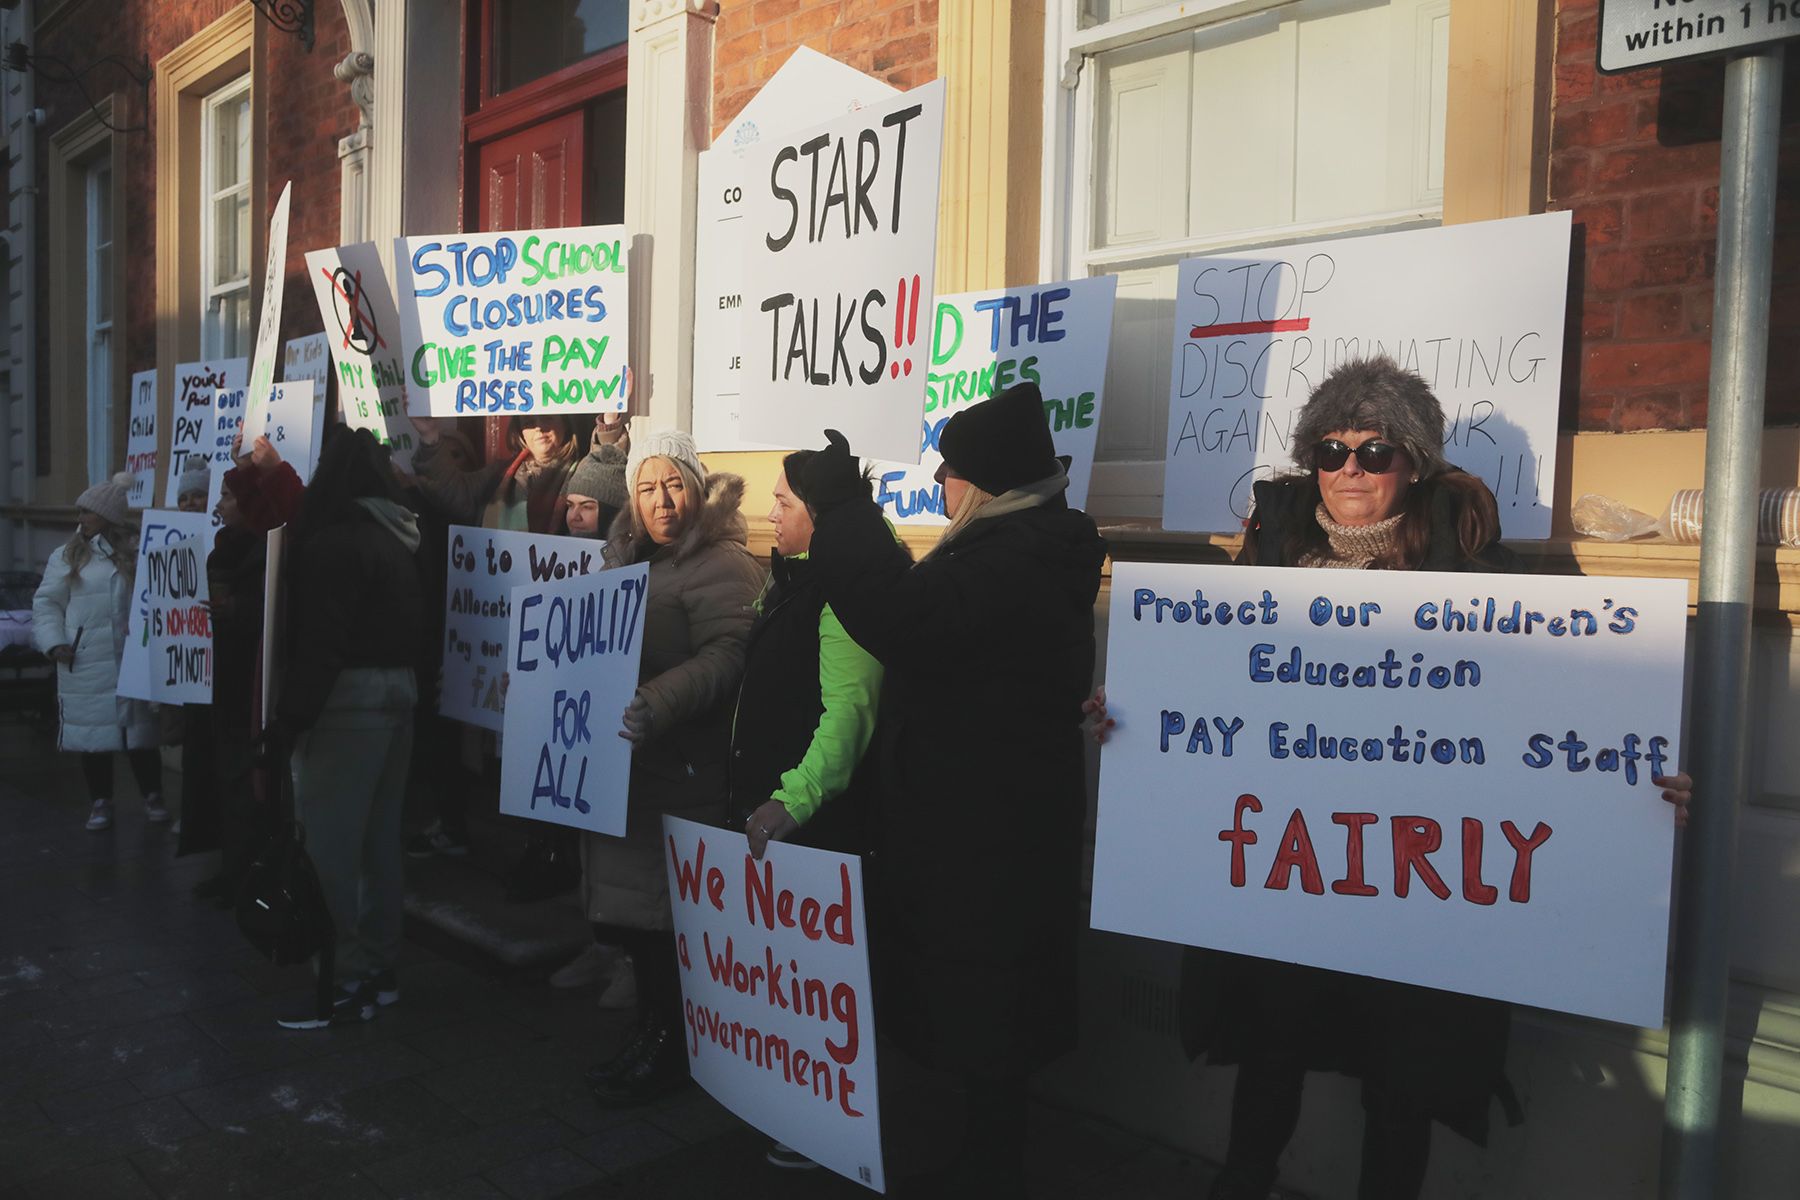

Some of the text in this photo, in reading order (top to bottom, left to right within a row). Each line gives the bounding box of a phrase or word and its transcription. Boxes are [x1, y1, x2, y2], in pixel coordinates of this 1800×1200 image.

[1625, 13, 1725, 51] within
[1740, 2, 1751, 29] 1
[766, 103, 922, 253] START
[412, 236, 625, 297] STOP SCHOOL
[1191, 253, 1335, 328] STOP
[444, 285, 607, 337] CLOSURES
[760, 274, 920, 386] TALKS!!
[975, 287, 1071, 353] THE
[339, 361, 364, 388] MY
[412, 335, 609, 388] GIVE THE PAY
[456, 365, 626, 413] RISES NOW!
[175, 417, 202, 445] PAY
[1174, 408, 1293, 456] AGAIN
[168, 546, 198, 600] CHILD
[452, 534, 592, 582] Go to Work
[152, 608, 163, 637] IS
[517, 573, 647, 671] EQUALITY
[1133, 588, 1279, 627] Protect
[1309, 595, 1382, 627] Our
[1249, 643, 1482, 689] Education
[552, 690, 591, 750] FOR
[1160, 709, 1670, 786] PAY Education Staff
[530, 742, 591, 814] ALL
[669, 835, 855, 946] We Need
[678, 931, 859, 1065] a Working
[685, 997, 865, 1118] government
